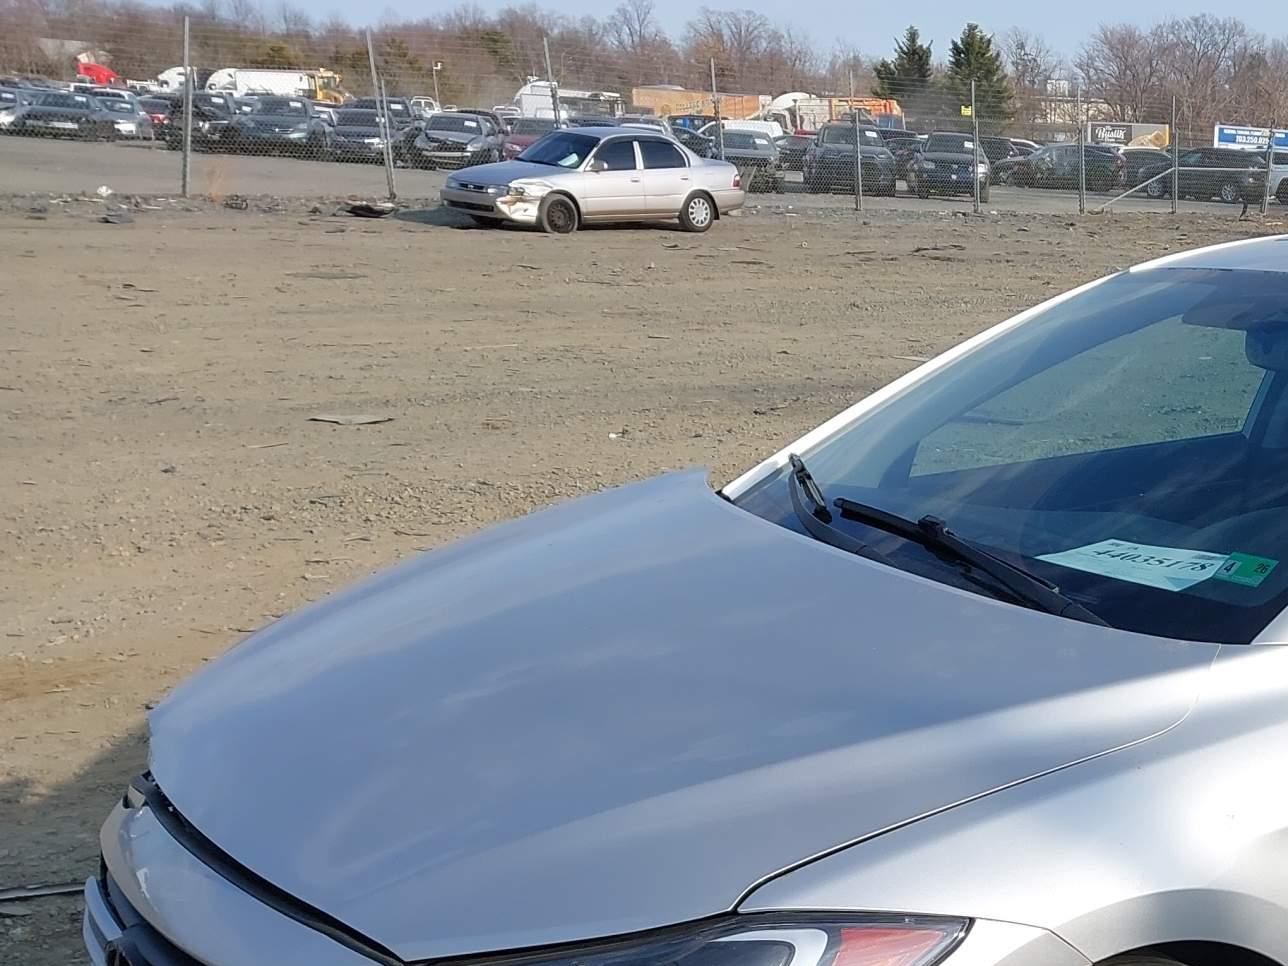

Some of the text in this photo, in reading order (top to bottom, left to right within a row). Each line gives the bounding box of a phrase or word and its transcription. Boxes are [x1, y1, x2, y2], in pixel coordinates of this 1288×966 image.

[1093, 549, 1215, 572] 44035178
[1223, 561, 1269, 574] 4 26
